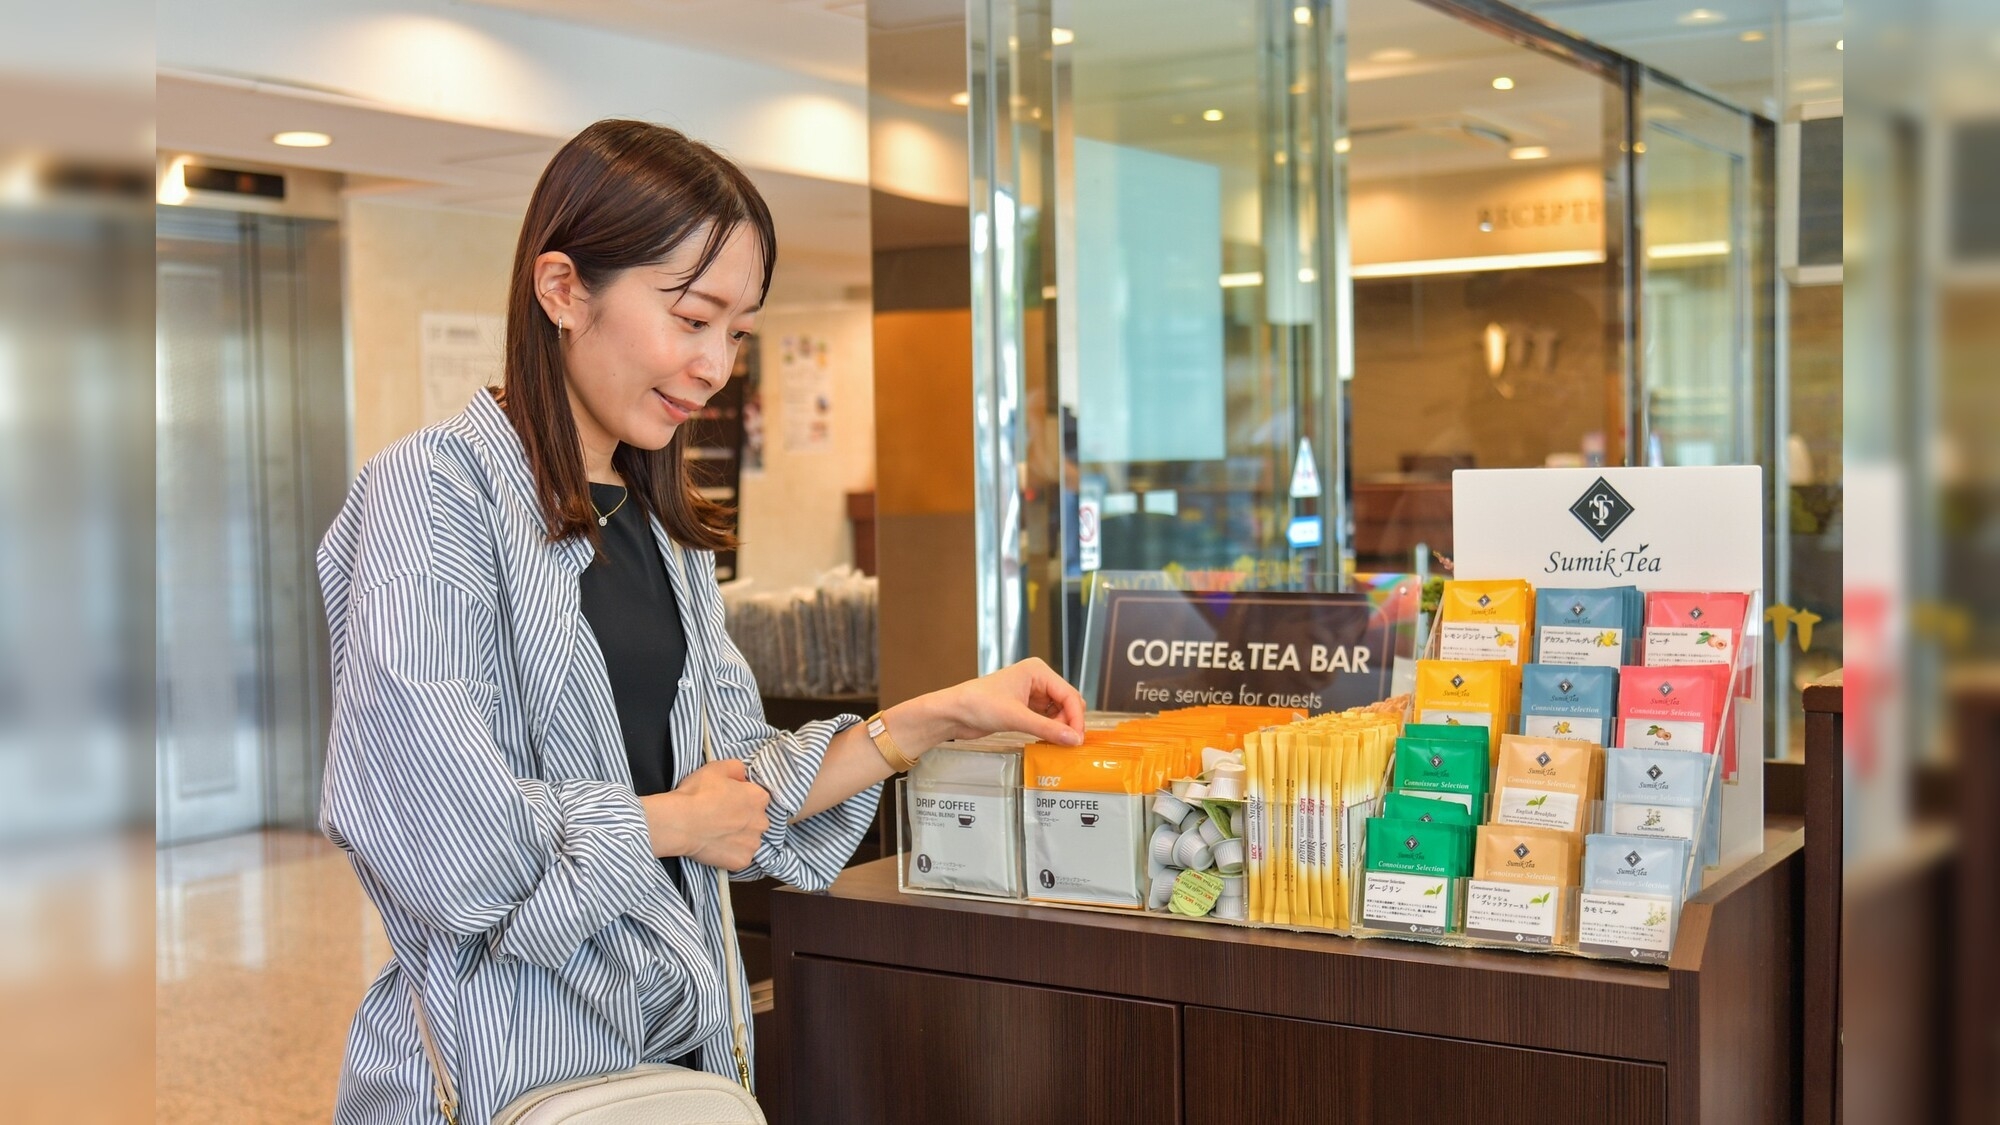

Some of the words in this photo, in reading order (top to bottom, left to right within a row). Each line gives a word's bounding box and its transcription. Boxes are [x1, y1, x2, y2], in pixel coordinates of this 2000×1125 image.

[1544, 548, 1622, 578] Sumik
[1620, 545, 1662, 573] Tea
[1309, 643, 1371, 674] BAR
[1134, 681, 1170, 703] Free
[1174, 686, 1234, 705] service
[1238, 683, 1263, 706] for
[1531, 704, 1568, 713] Connoisseur
[1569, 705, 1600, 714] Selection
[1629, 706, 1670, 716] Connoisseur
[1670, 708, 1702, 718] Selection
[1404, 779, 1439, 788] Connoisseur
[1440, 781, 1470, 790] Selection
[916, 797, 936, 809] DRIP
[938, 800, 976, 812] COFFEE
[1036, 797, 1057, 809] DRIP
[1059, 799, 1099, 811] COFFEE
[1378, 860, 1415, 870] Connoisseur
[1415, 863, 1446, 873] Selection
[1368, 883, 1402, 893] ダージリン
[1471, 892, 1508, 902] イングリッシュ
[1481, 899, 1530, 910] ブレックファースト
[1583, 905, 1618, 915] カモミール
